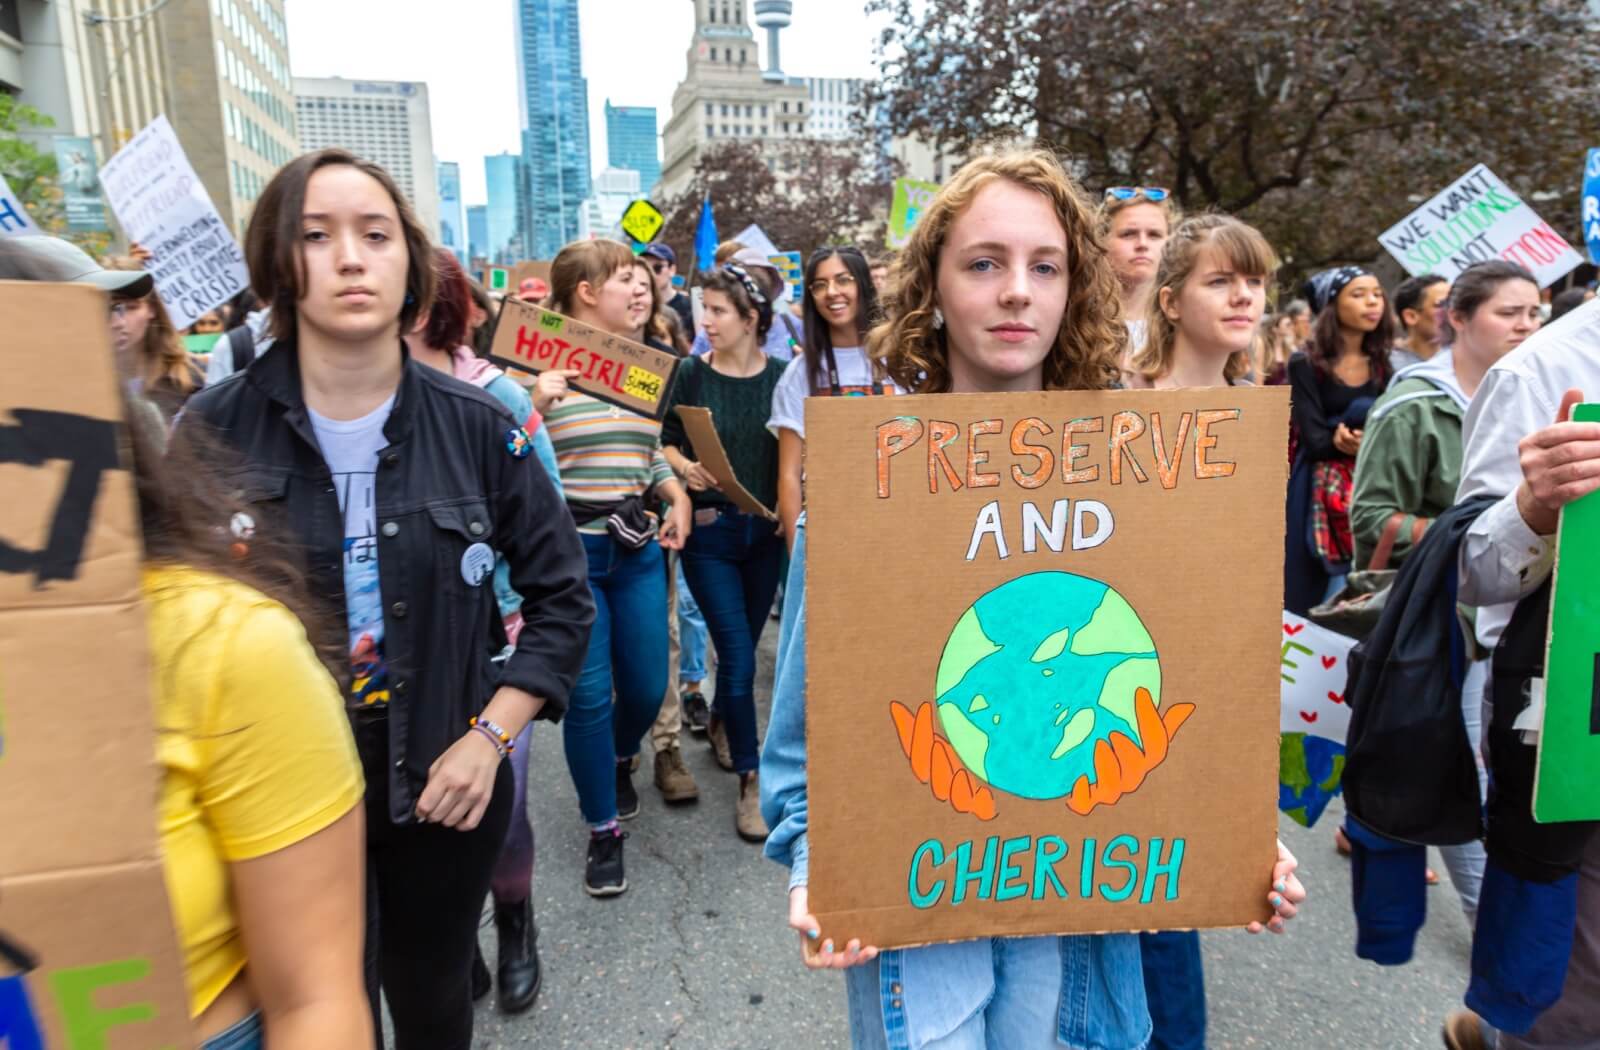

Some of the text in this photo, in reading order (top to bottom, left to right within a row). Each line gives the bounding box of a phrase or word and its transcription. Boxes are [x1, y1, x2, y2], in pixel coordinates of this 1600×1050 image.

[1387, 170, 1490, 250] WE WANT
[1407, 186, 1521, 277] SOLUTIONS
[160, 242, 241, 304] OUR CLIMATE
[1451, 233, 1497, 272] NOT
[179, 269, 240, 319] CRISIS
[541, 314, 563, 328] NOT
[876, 408, 1241, 498] PRESERVE
[966, 499, 1115, 560] AND
[908, 834, 1186, 909] CHERISH
